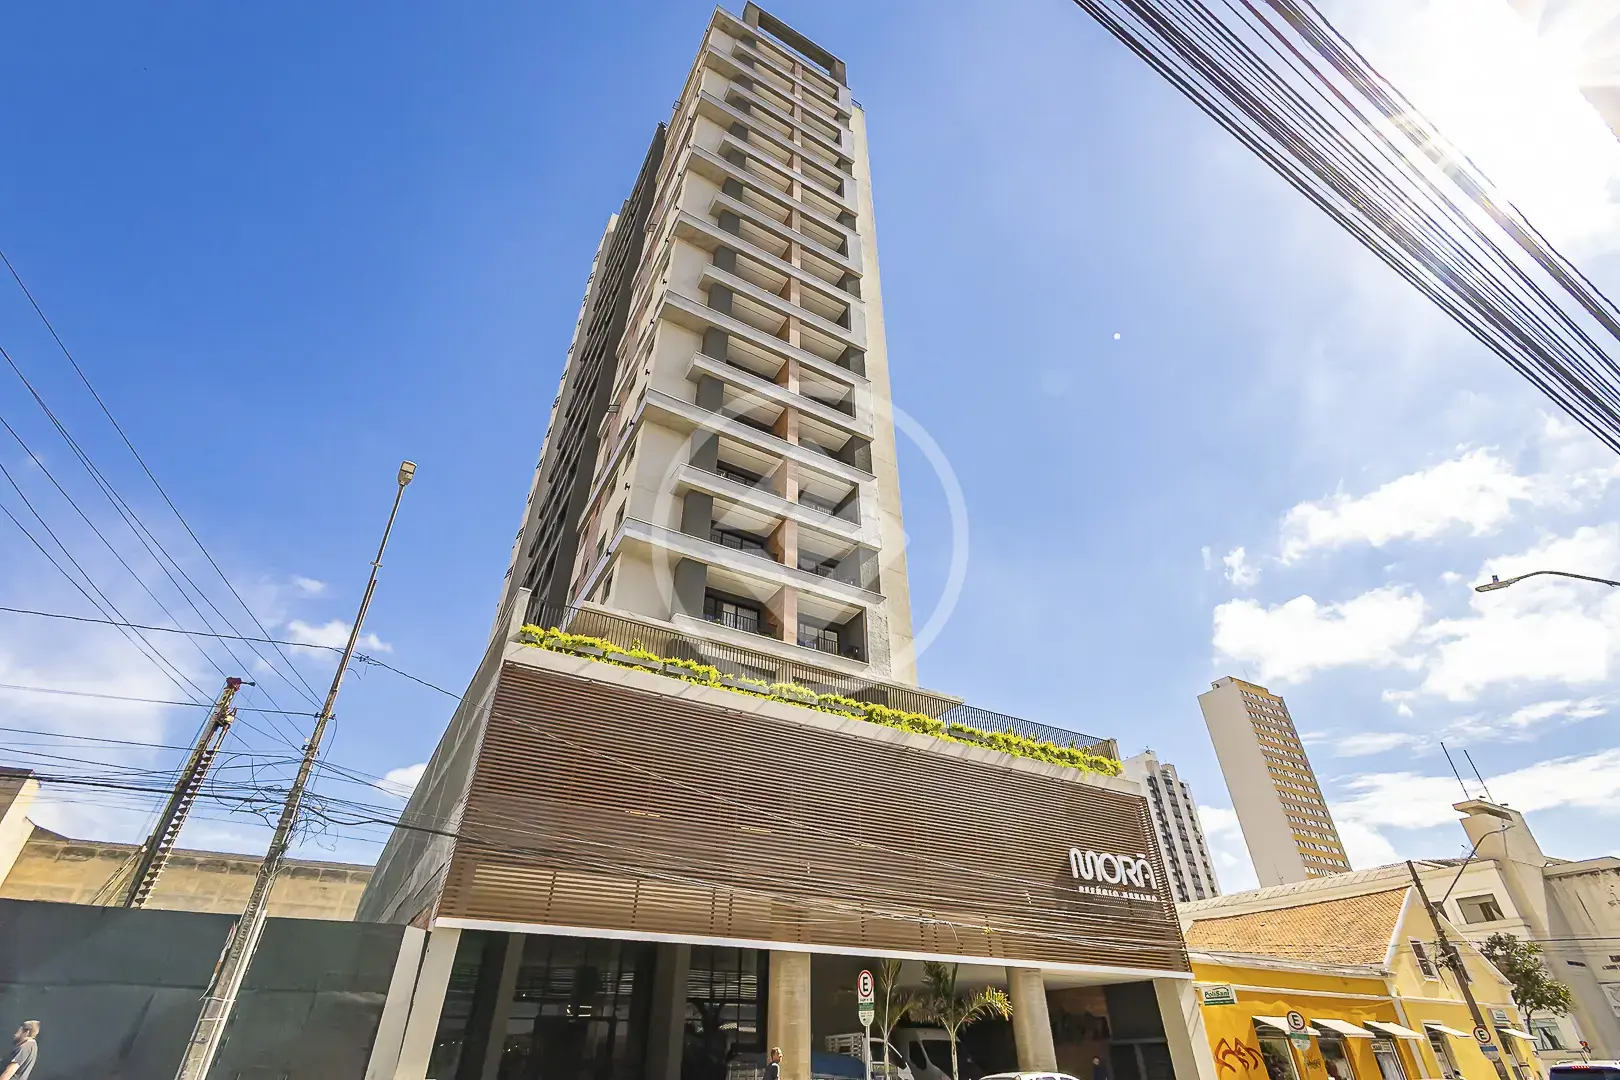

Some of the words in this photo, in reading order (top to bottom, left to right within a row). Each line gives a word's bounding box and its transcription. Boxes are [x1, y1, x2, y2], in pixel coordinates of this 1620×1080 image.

[862, 976, 869, 992] E
[1291, 1014, 1301, 1027] E
[1477, 1029, 1488, 1041] E
